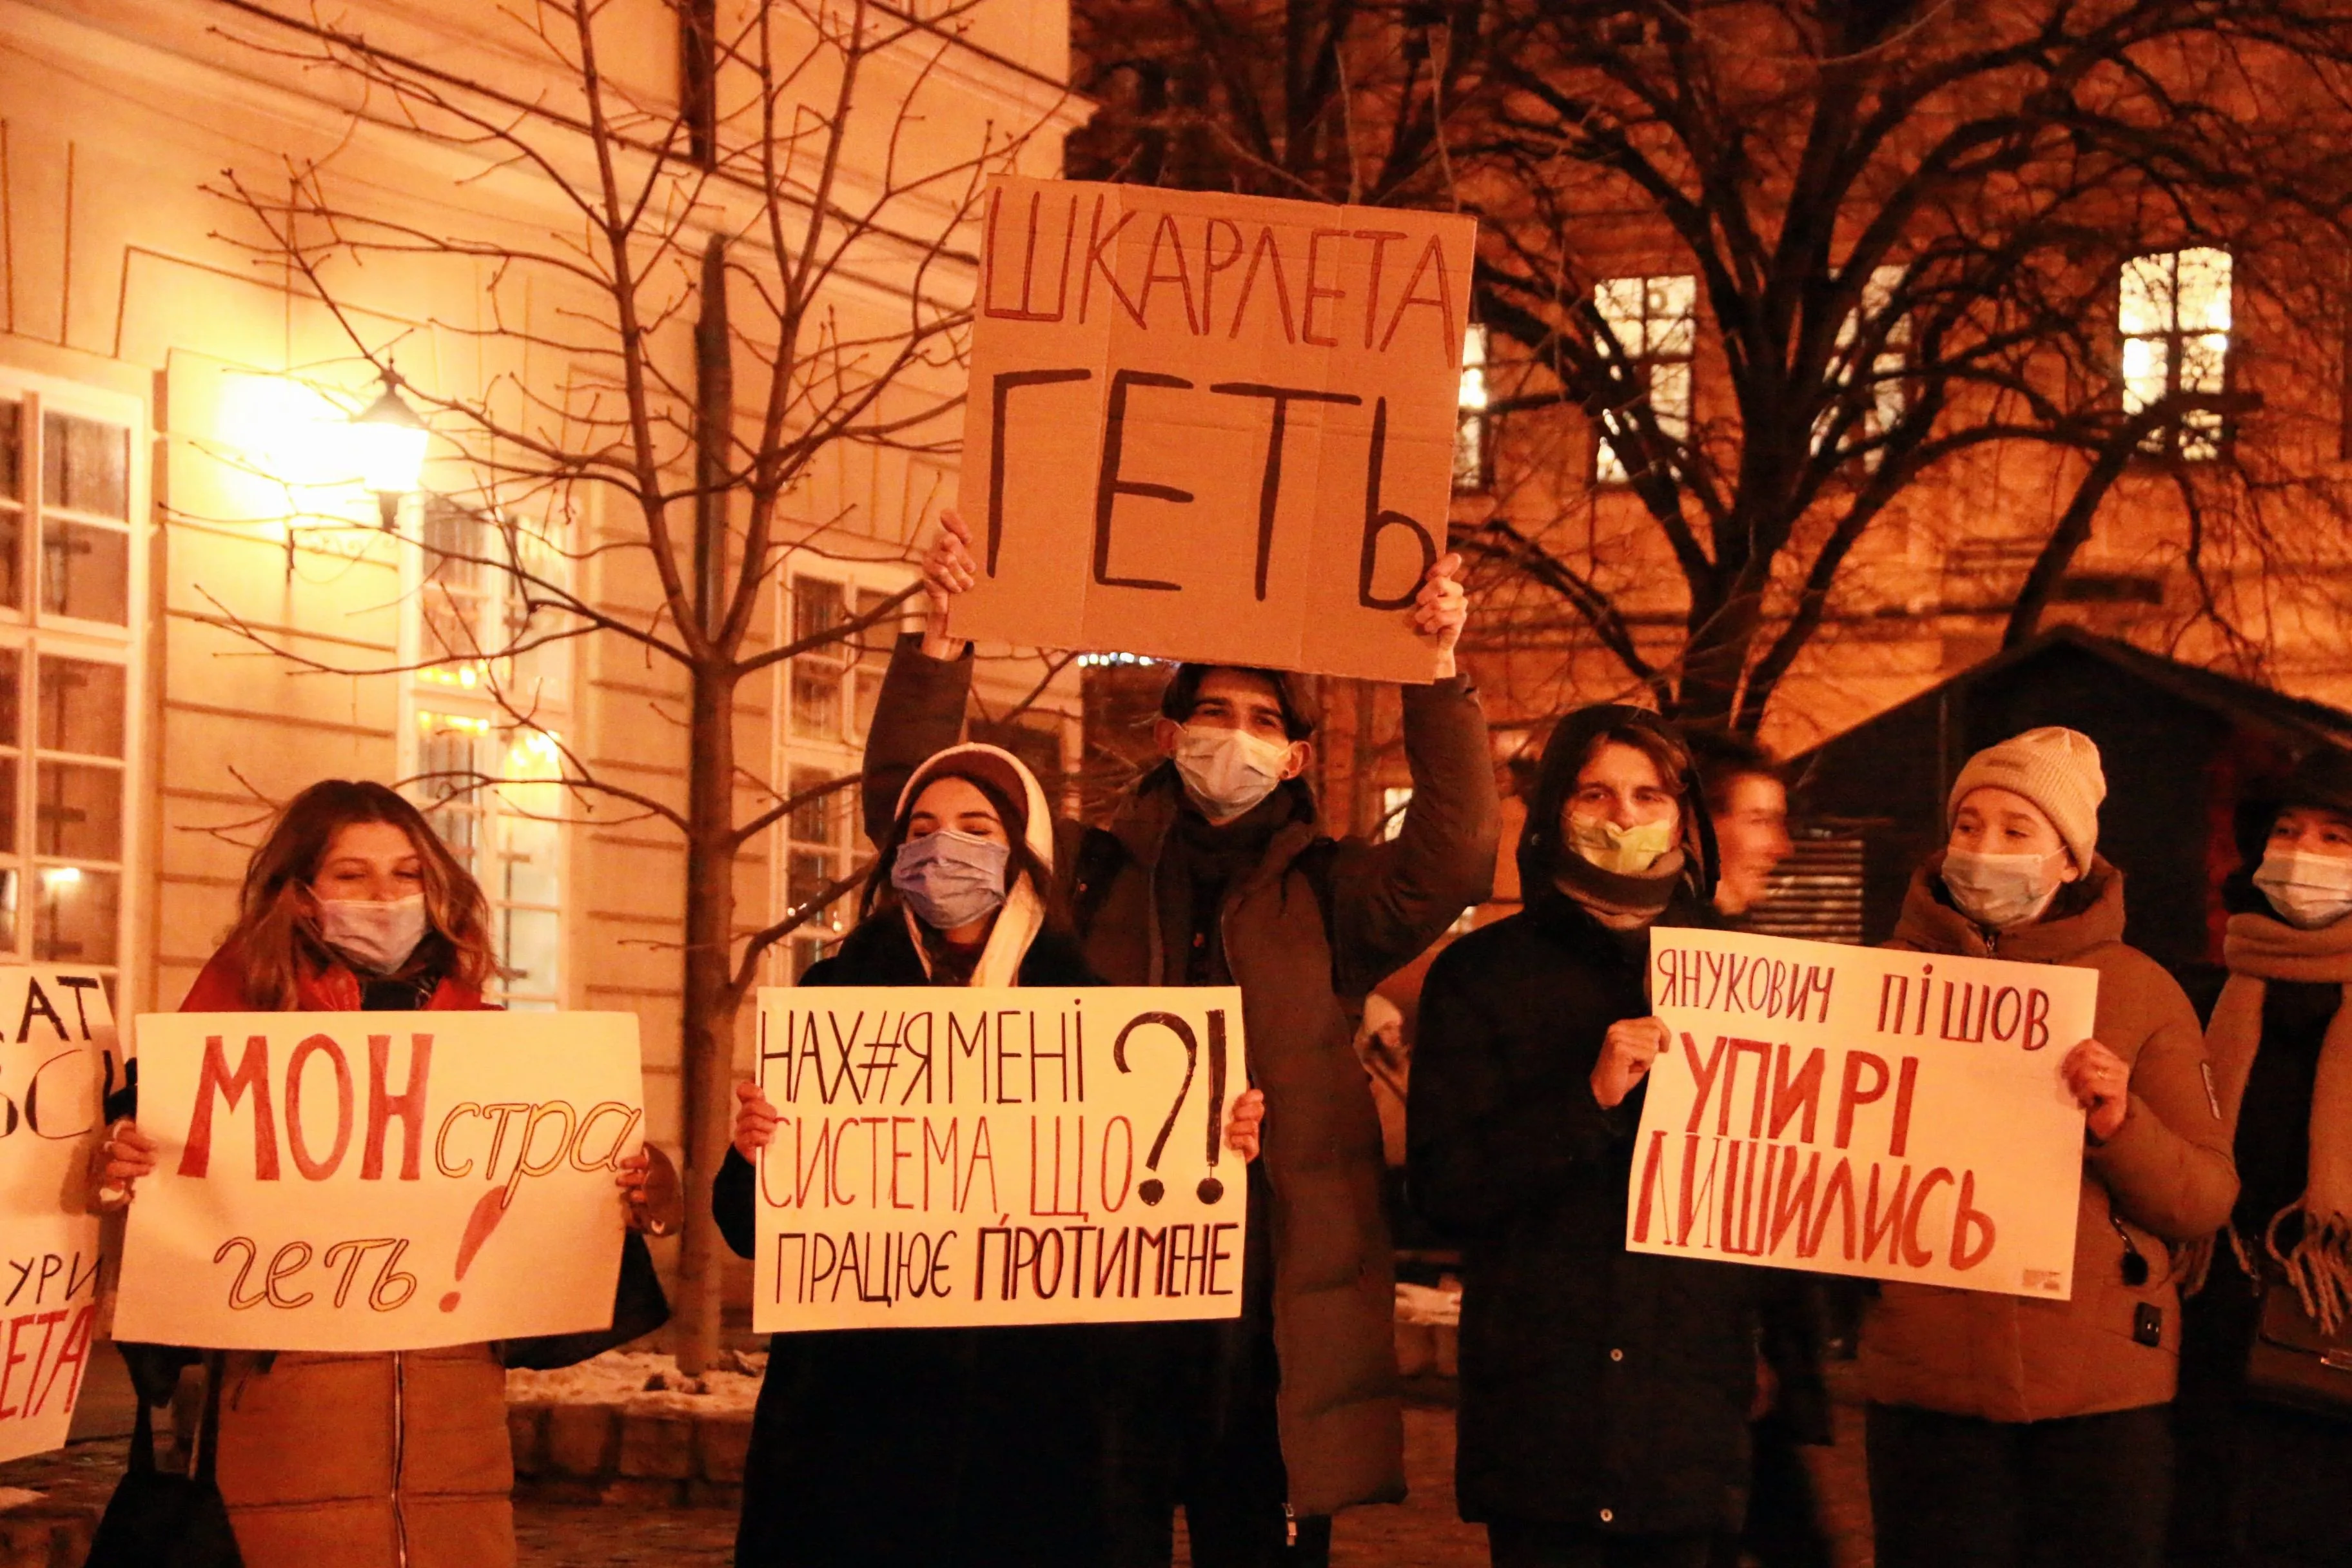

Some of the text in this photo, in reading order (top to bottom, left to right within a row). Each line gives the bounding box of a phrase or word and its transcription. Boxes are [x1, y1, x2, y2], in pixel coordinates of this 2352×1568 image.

[985, 186, 1455, 369] ШКАРЛЕТА
[987, 368, 1436, 611] ГЕТЬ
[0, 975, 99, 1043] АТ
[1657, 948, 2049, 1050] ЯНУКОВИЧ ПІШОВ
[1680, 1032, 1919, 1157] УПИРІ
[1030, 1115, 1133, 1222] ЩО
[1632, 1130, 1996, 1270] ЛИШИЛИСЬ
[776, 1230, 957, 1308] ПРАЦЮЄ
